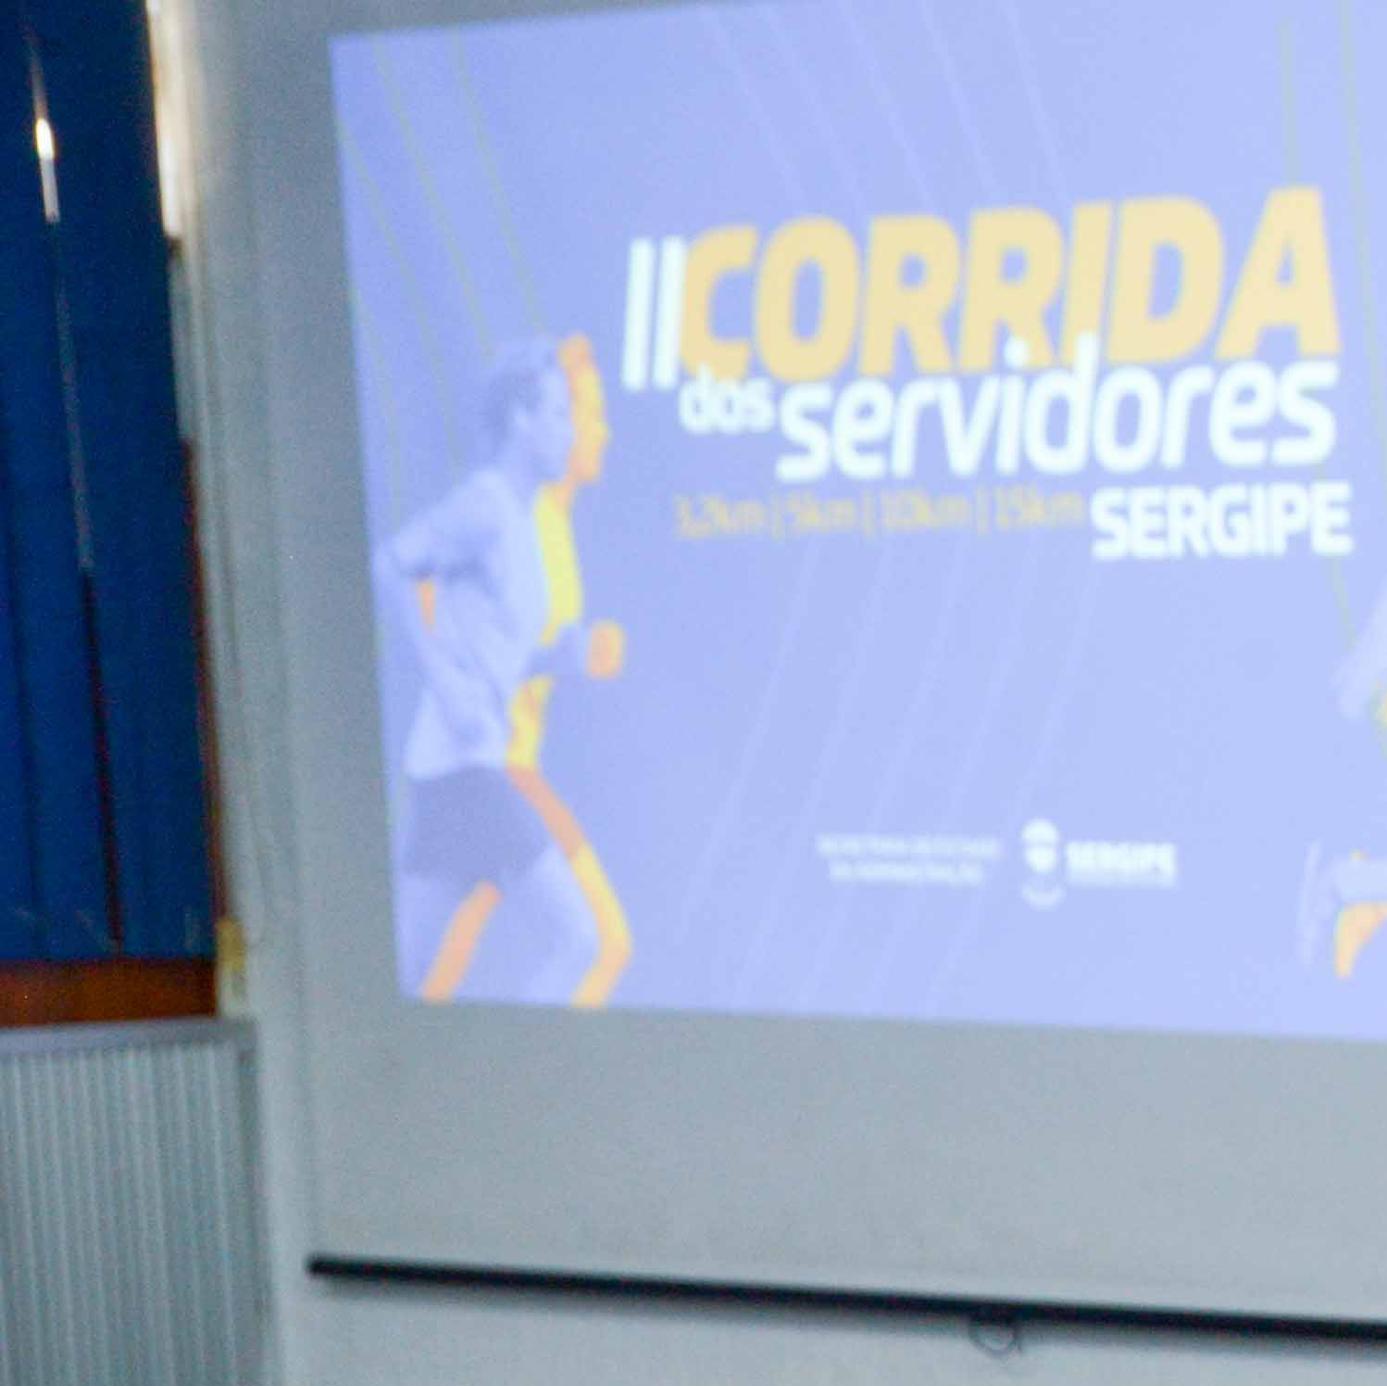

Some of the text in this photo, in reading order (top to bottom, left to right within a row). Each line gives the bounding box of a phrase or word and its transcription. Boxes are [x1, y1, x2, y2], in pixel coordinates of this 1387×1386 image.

[679, 185, 1341, 382] CORRIDA
[679, 331, 1338, 482] dos servidores
[1090, 482, 1353, 561] SERGIPE
